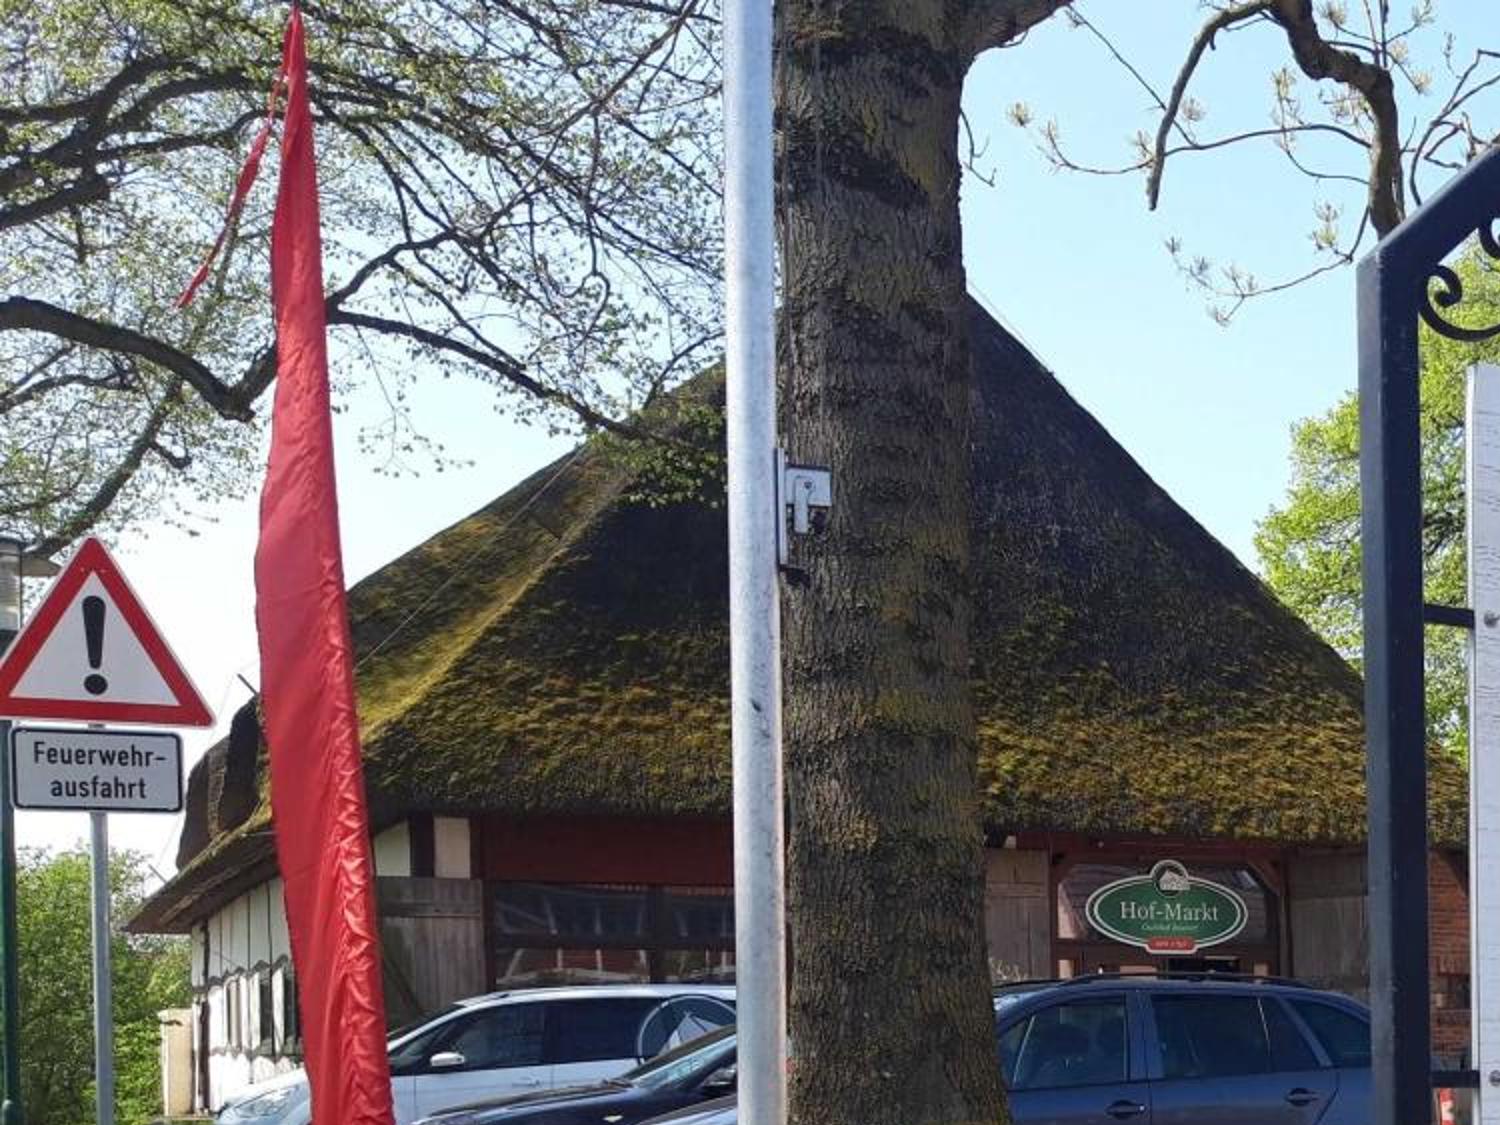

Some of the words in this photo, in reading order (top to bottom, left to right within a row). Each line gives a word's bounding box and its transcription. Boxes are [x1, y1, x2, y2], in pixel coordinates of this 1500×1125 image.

[34, 741, 167, 767] Feuerwehr-
[51, 775, 147, 800] ausfahrt
[1120, 901, 1219, 921] Hof-Markt
